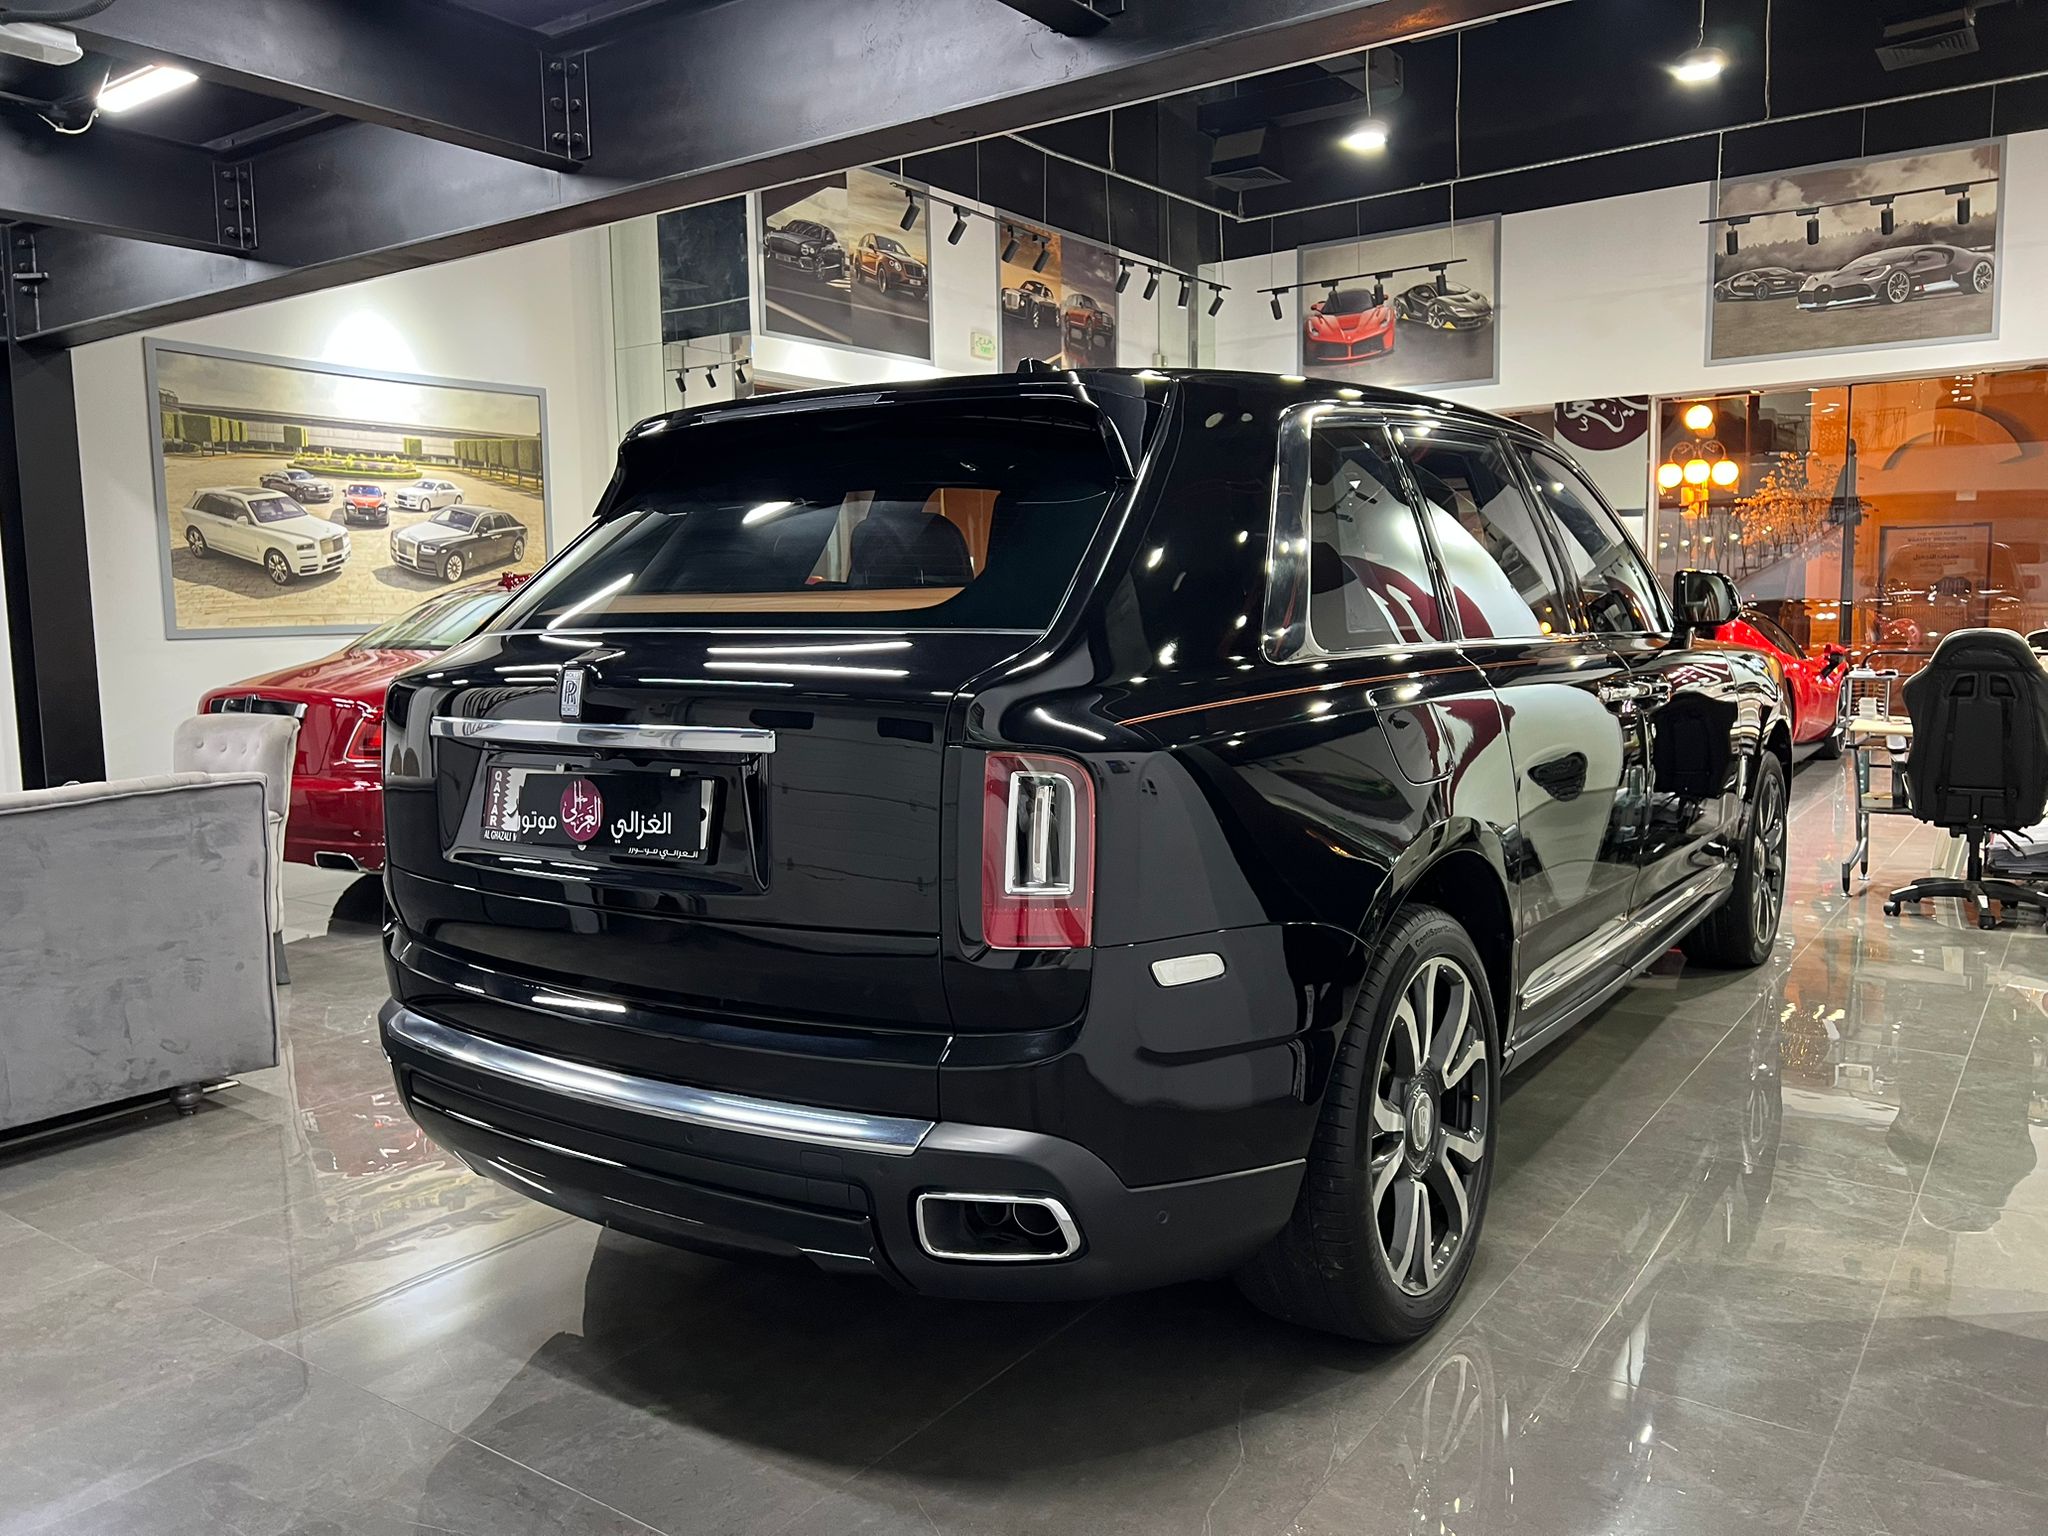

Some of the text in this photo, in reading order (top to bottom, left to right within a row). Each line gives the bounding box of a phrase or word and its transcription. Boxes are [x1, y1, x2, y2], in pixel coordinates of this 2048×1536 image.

[489, 770, 503, 827] QATAR
[483, 829, 491, 840] AL
[490, 830, 512, 842] GHAZALI
[610, 810, 672, 844] الغزالي
